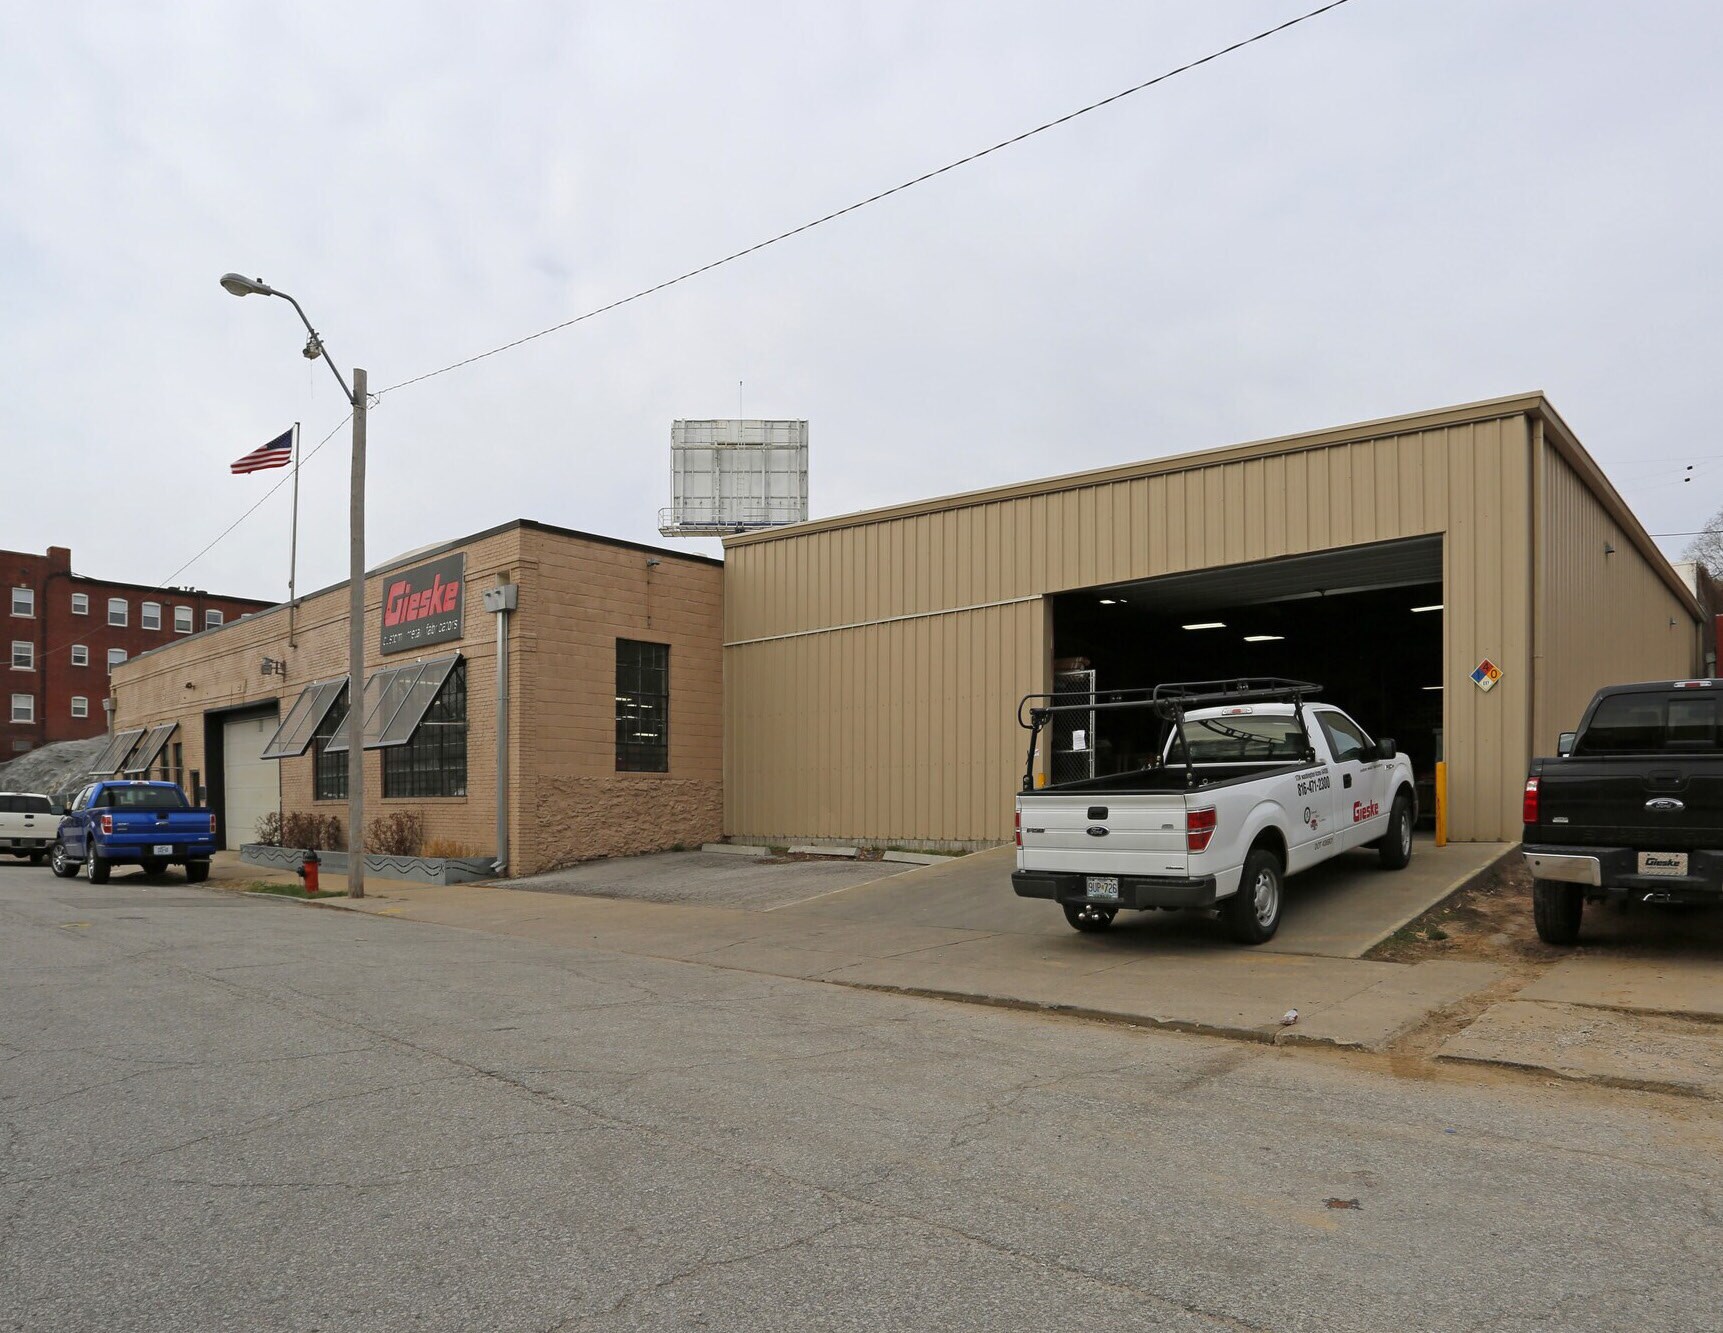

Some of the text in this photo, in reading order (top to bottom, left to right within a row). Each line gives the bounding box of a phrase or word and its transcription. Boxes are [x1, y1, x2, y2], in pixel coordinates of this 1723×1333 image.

[384, 573, 459, 627] Gieske
[1353, 800, 1379, 822] Gieske
[1645, 858, 1680, 867] Gieske
